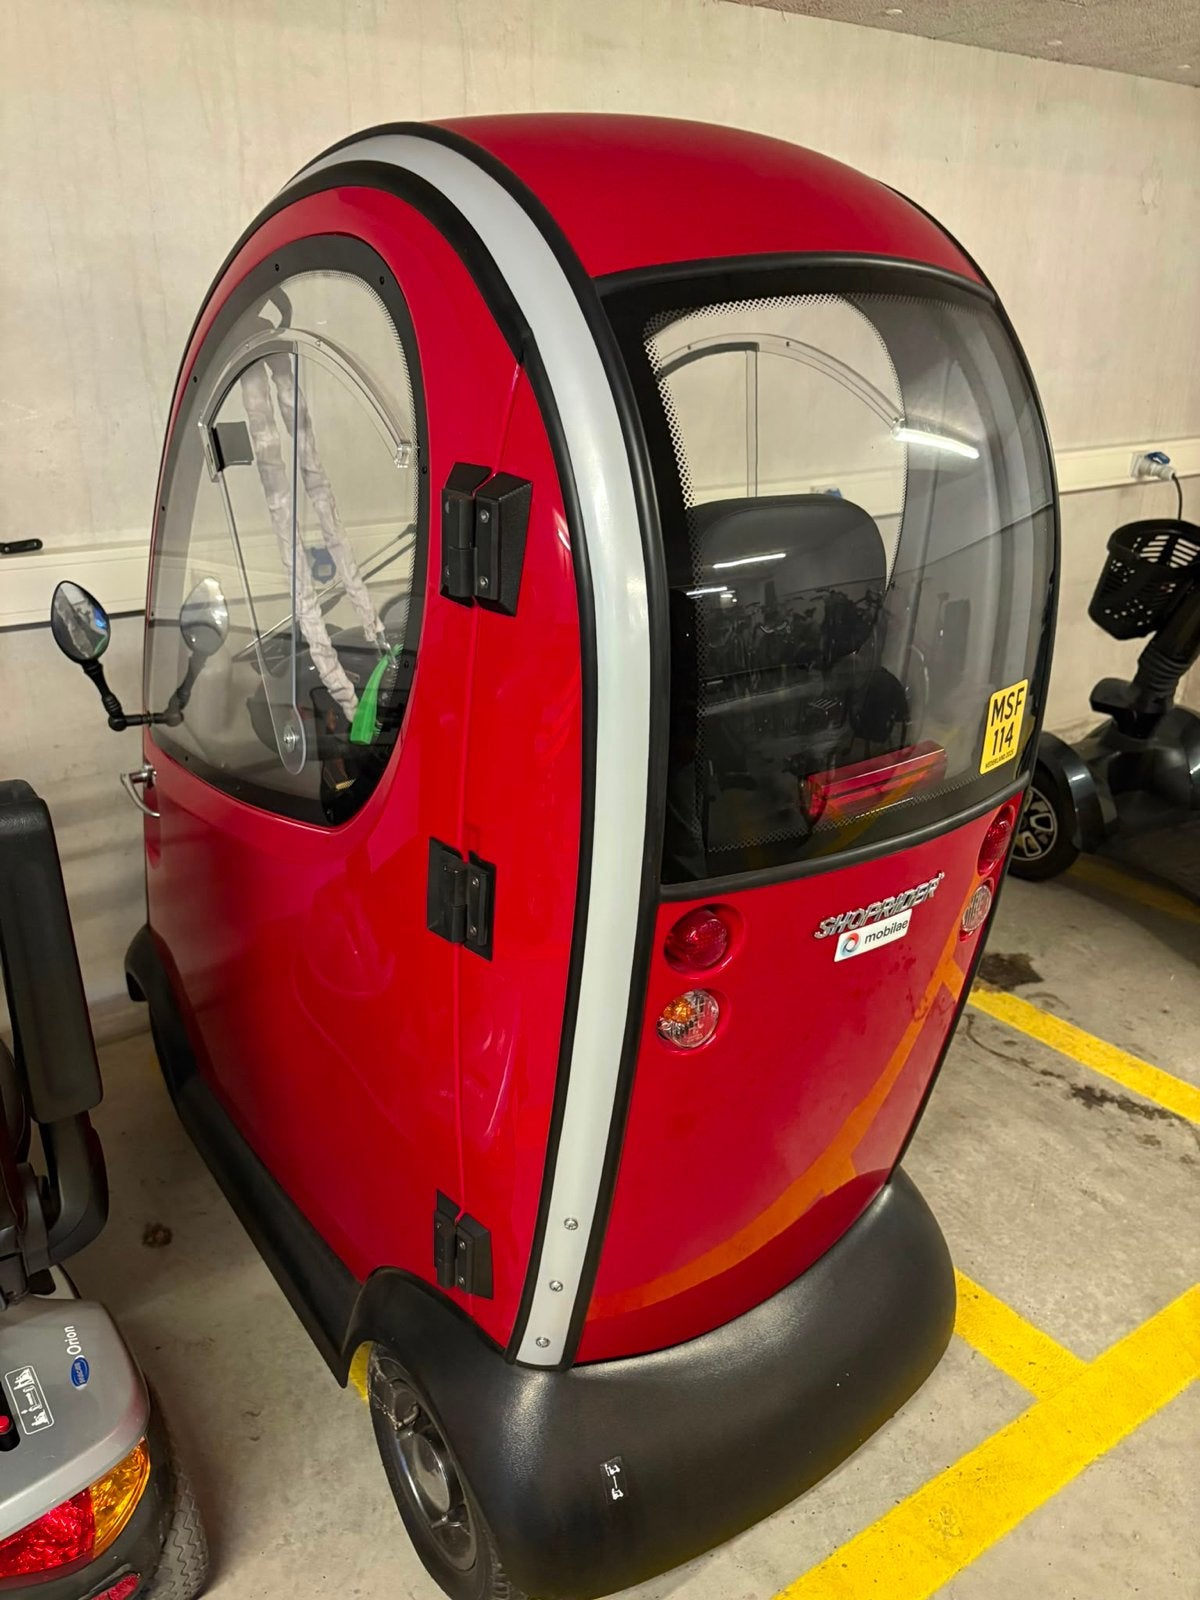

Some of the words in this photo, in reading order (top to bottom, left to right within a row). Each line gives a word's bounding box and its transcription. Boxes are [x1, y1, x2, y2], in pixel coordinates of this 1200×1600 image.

[990, 687, 1025, 727] MSF
[992, 721, 1015, 756] 114
[813, 877, 940, 939] SHOPRIDER
[864, 918, 909, 945] mobilae
[64, 1325, 82, 1355] Orion
